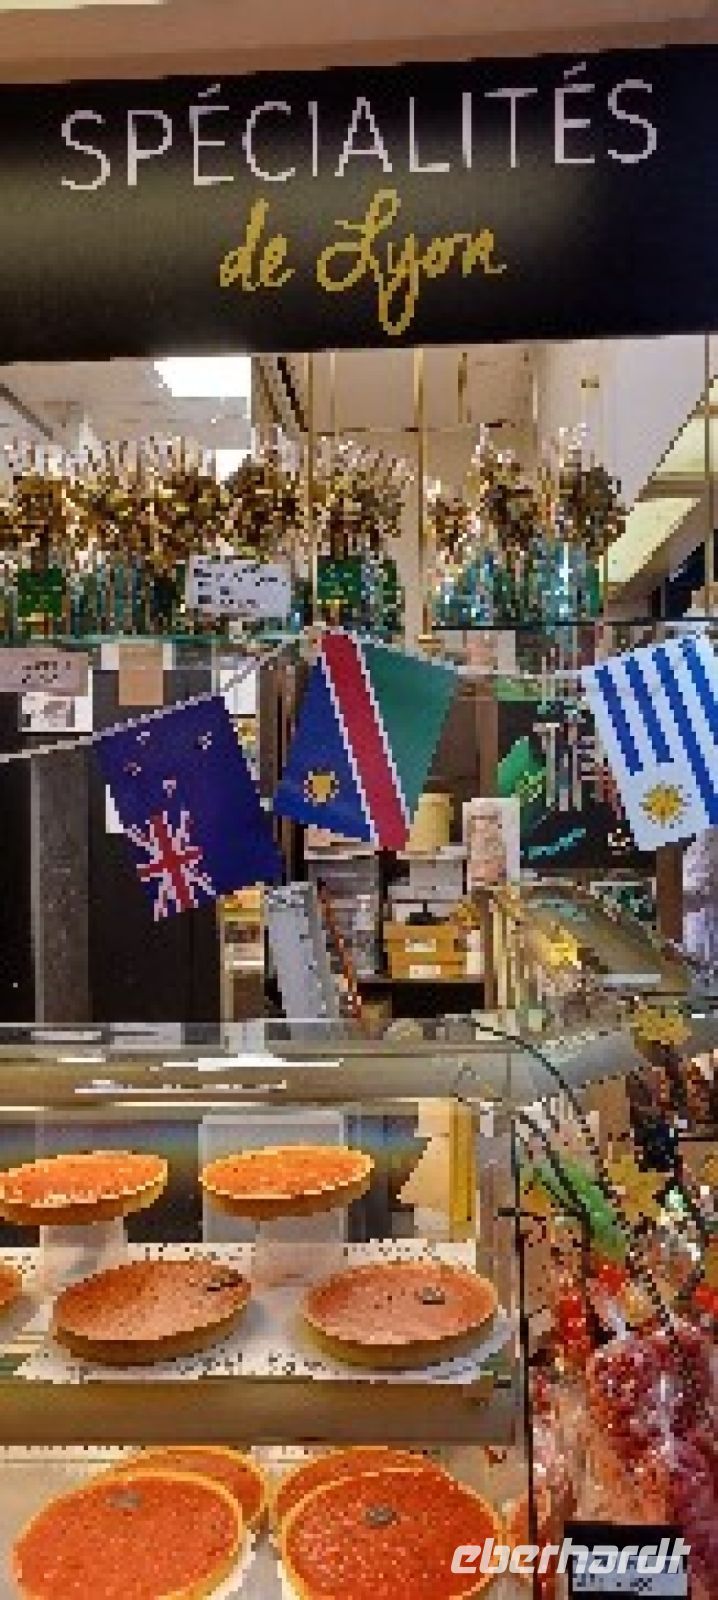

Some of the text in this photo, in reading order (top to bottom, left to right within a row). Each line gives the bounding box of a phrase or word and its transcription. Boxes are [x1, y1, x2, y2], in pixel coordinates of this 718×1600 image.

[60, 61, 658, 191] SPÉCIALITÉS
[218, 188, 508, 336] de Lyon
